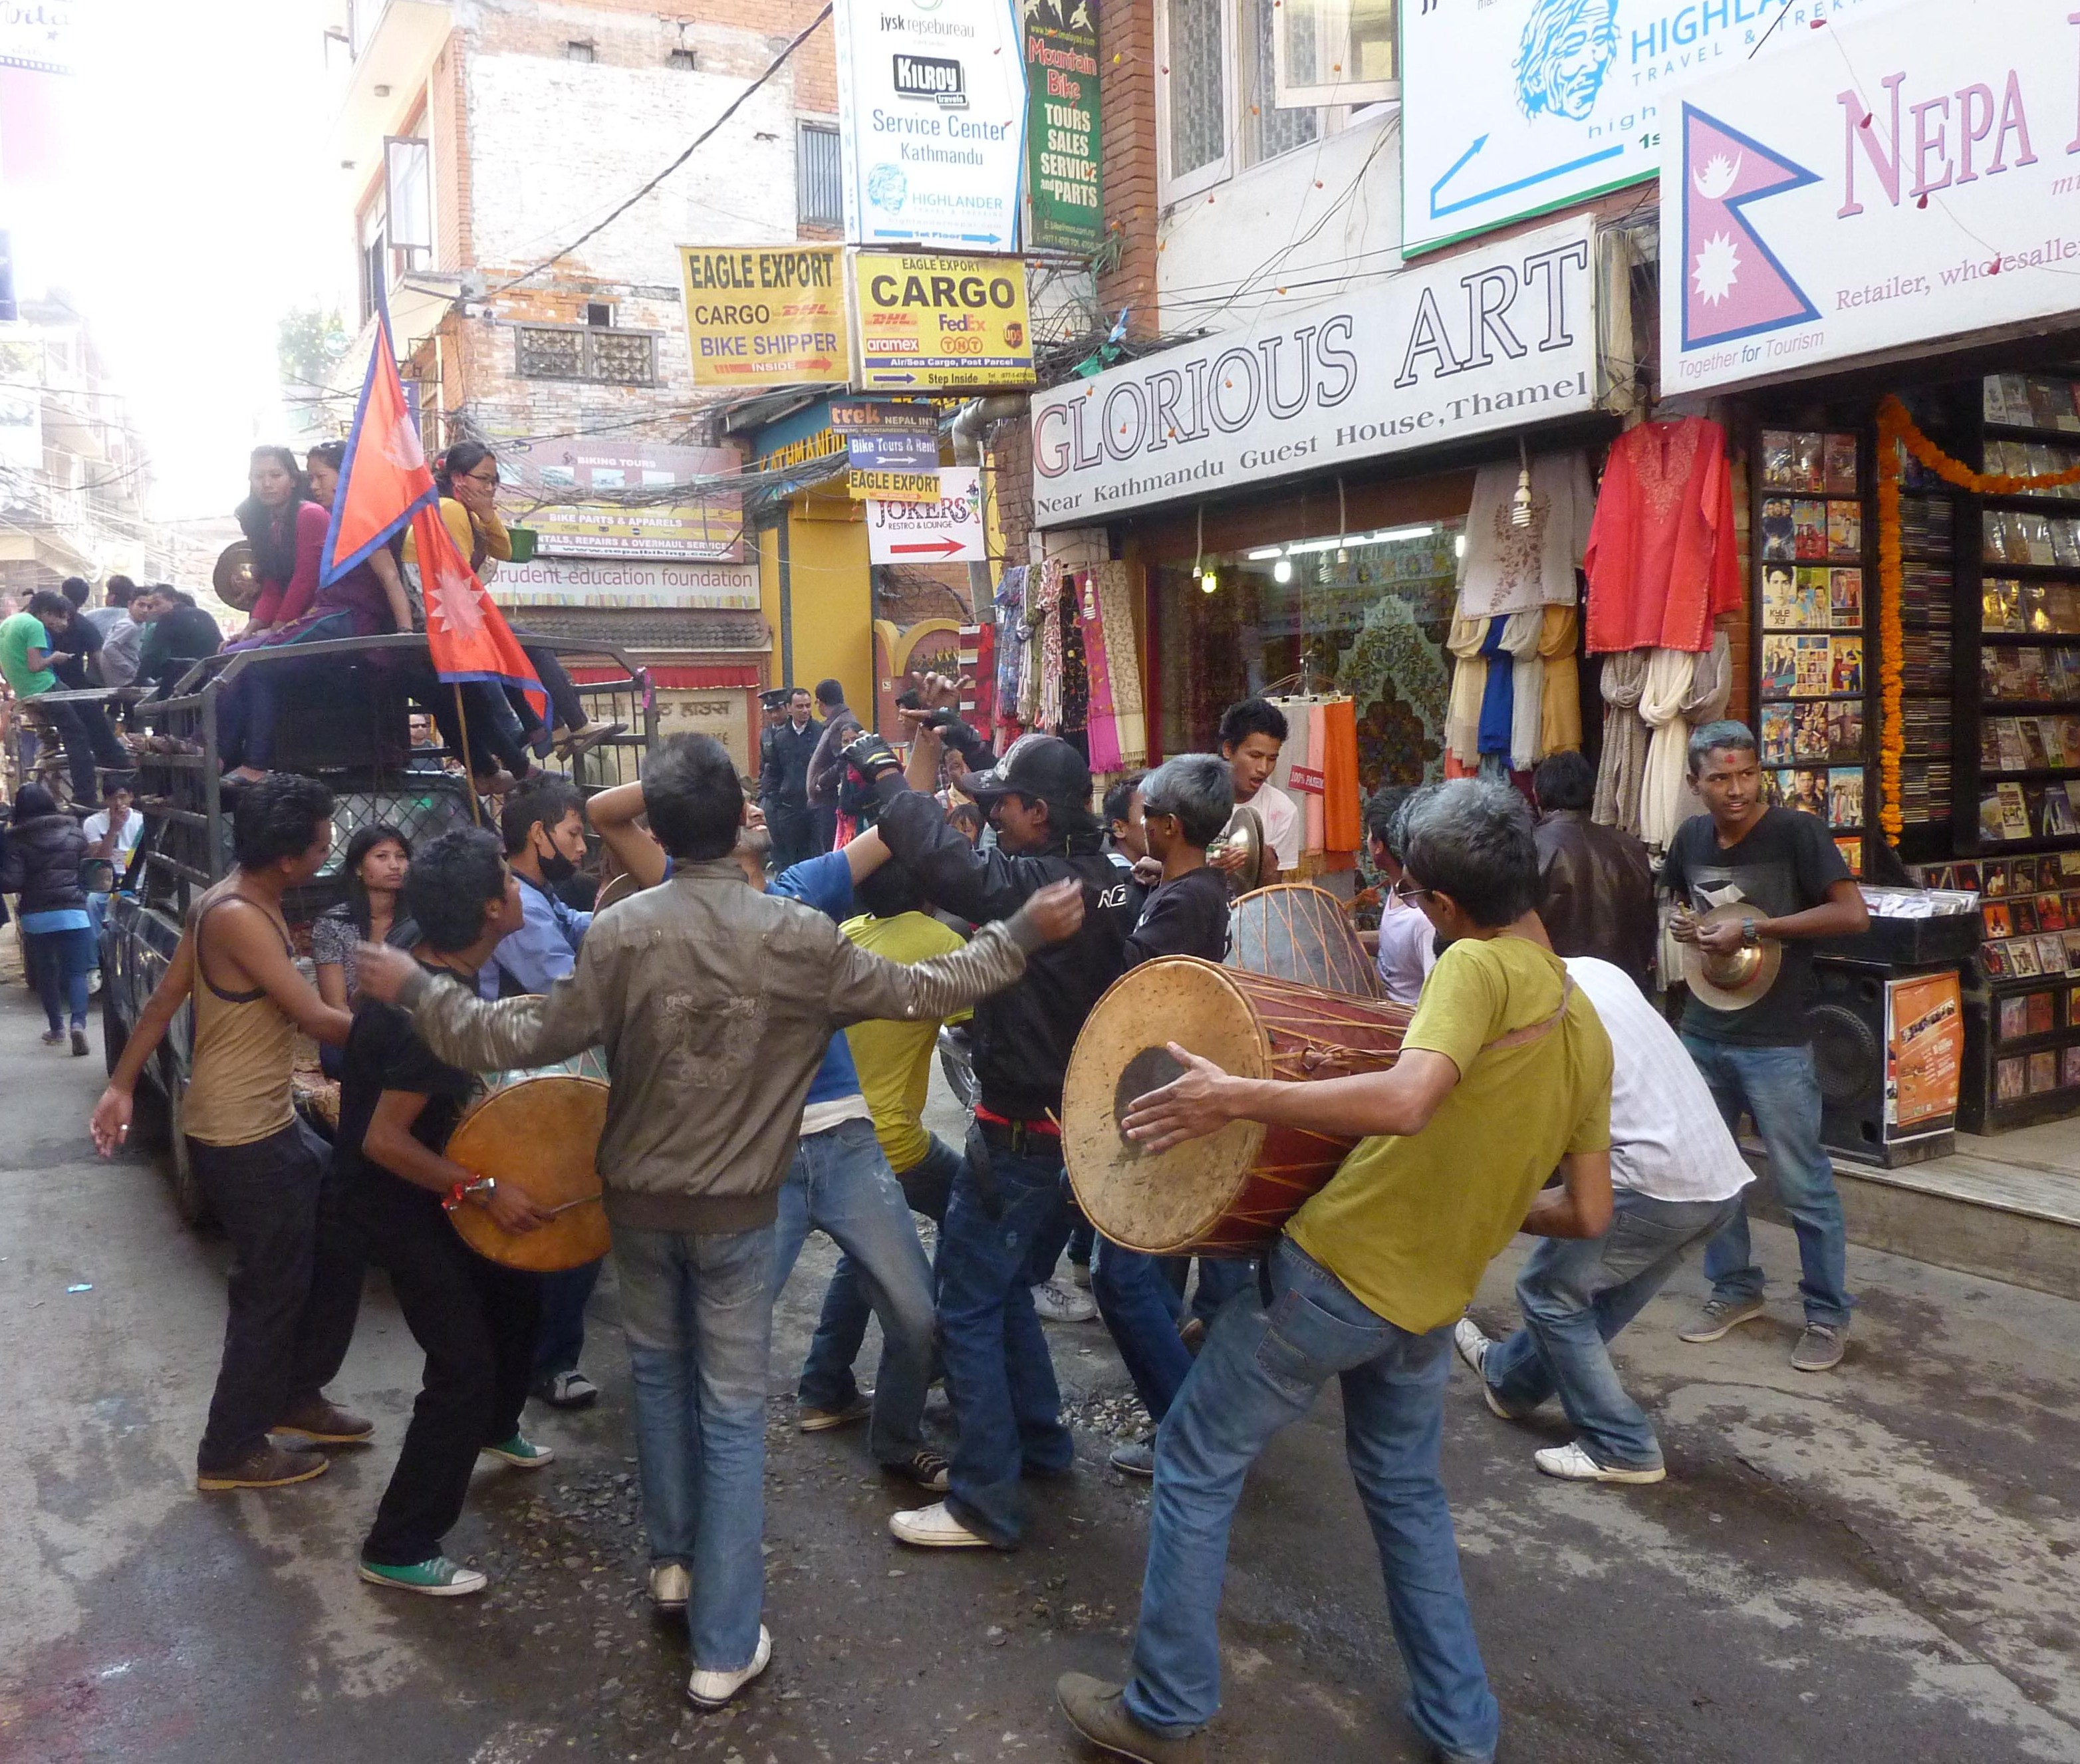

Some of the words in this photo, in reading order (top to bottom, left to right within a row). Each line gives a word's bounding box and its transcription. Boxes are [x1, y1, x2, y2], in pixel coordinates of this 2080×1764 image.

[880, 13, 905, 32] jysk
[907, 18, 974, 38] rejsebureau
[1029, 35, 1097, 76] Mountain
[1632, 43, 1723, 86] TRAVEL
[1744, 29, 1755, 45] &
[897, 58, 958, 92] KILROY
[1047, 68, 1081, 100] Bike
[872, 109, 940, 136] Service
[948, 115, 1007, 141] Center
[1044, 103, 1091, 133] TOURS
[901, 142, 983, 166] Kathmandu
[1048, 129, 1089, 157] SALES
[1837, 68, 2039, 219] NEPA
[1040, 153, 1098, 183] SERVICE
[912, 193, 1003, 209] HIGHLANDER
[1041, 178, 1055, 191] and
[1054, 180, 1099, 209] PARTS
[689, 254, 755, 289] EAGLE
[759, 253, 833, 288] EXPORT
[902, 258, 937, 271] EAGLE
[940, 260, 981, 272] EXPORT
[1835, 277, 1932, 311] Retailer,
[1939, 237, 2080, 287] wholesalle
[870, 275, 1015, 309] CARGO
[695, 305, 770, 325] CARGO
[782, 304, 830, 316] DHL
[939, 313, 986, 332] FedEx
[700, 336, 748, 356] BIKE
[753, 333, 837, 355] SHIPPER
[867, 338, 918, 352] aramex
[1004, 326, 1023, 346] ups
[928, 358, 958, 368] Cargo,
[984, 358, 1013, 366] Parcel
[1033, 314, 1359, 479] GLORIOUS
[1395, 239, 1589, 390] ART
[1678, 348, 1738, 378] Together
[1741, 344, 1761, 364] for
[1765, 330, 1825, 357] Tourism
[751, 361, 796, 372] INSIDE
[928, 374, 949, 384] Step
[952, 373, 978, 384] Inside
[831, 404, 880, 424] trek
[885, 416, 916, 425] NEPAL
[851, 438, 874, 454] Bike
[876, 438, 904, 452] Tours
[906, 438, 913, 451] &
[916, 439, 936, 453] Rent
[577, 456, 617, 466] BIKING
[620, 459, 656, 469] TOURS
[850, 471, 889, 490] EAGLE
[893, 474, 940, 492] EXPORT
[1036, 491, 1083, 517] Near
[1093, 458, 1225, 504] Kathmandu
[1239, 434, 1319, 471] Guest
[549, 513, 576, 523] BIKE
[579, 515, 614, 525] PARTS
[617, 516, 625, 525] &
[628, 517, 682, 527] APPARELS
[876, 497, 970, 528] JOKERS
[888, 522, 915, 531] RESTRO
[923, 521, 953, 530] LOUNGE
[538, 535, 573, 545] NTALS,
[576, 537, 618, 547] REPAIRS
[621, 539, 629, 547] &
[632, 539, 685, 549] OVERHAUL
[489, 565, 561, 586] prudent
[569, 567, 656, 586] education
[662, 568, 753, 587] foundation
